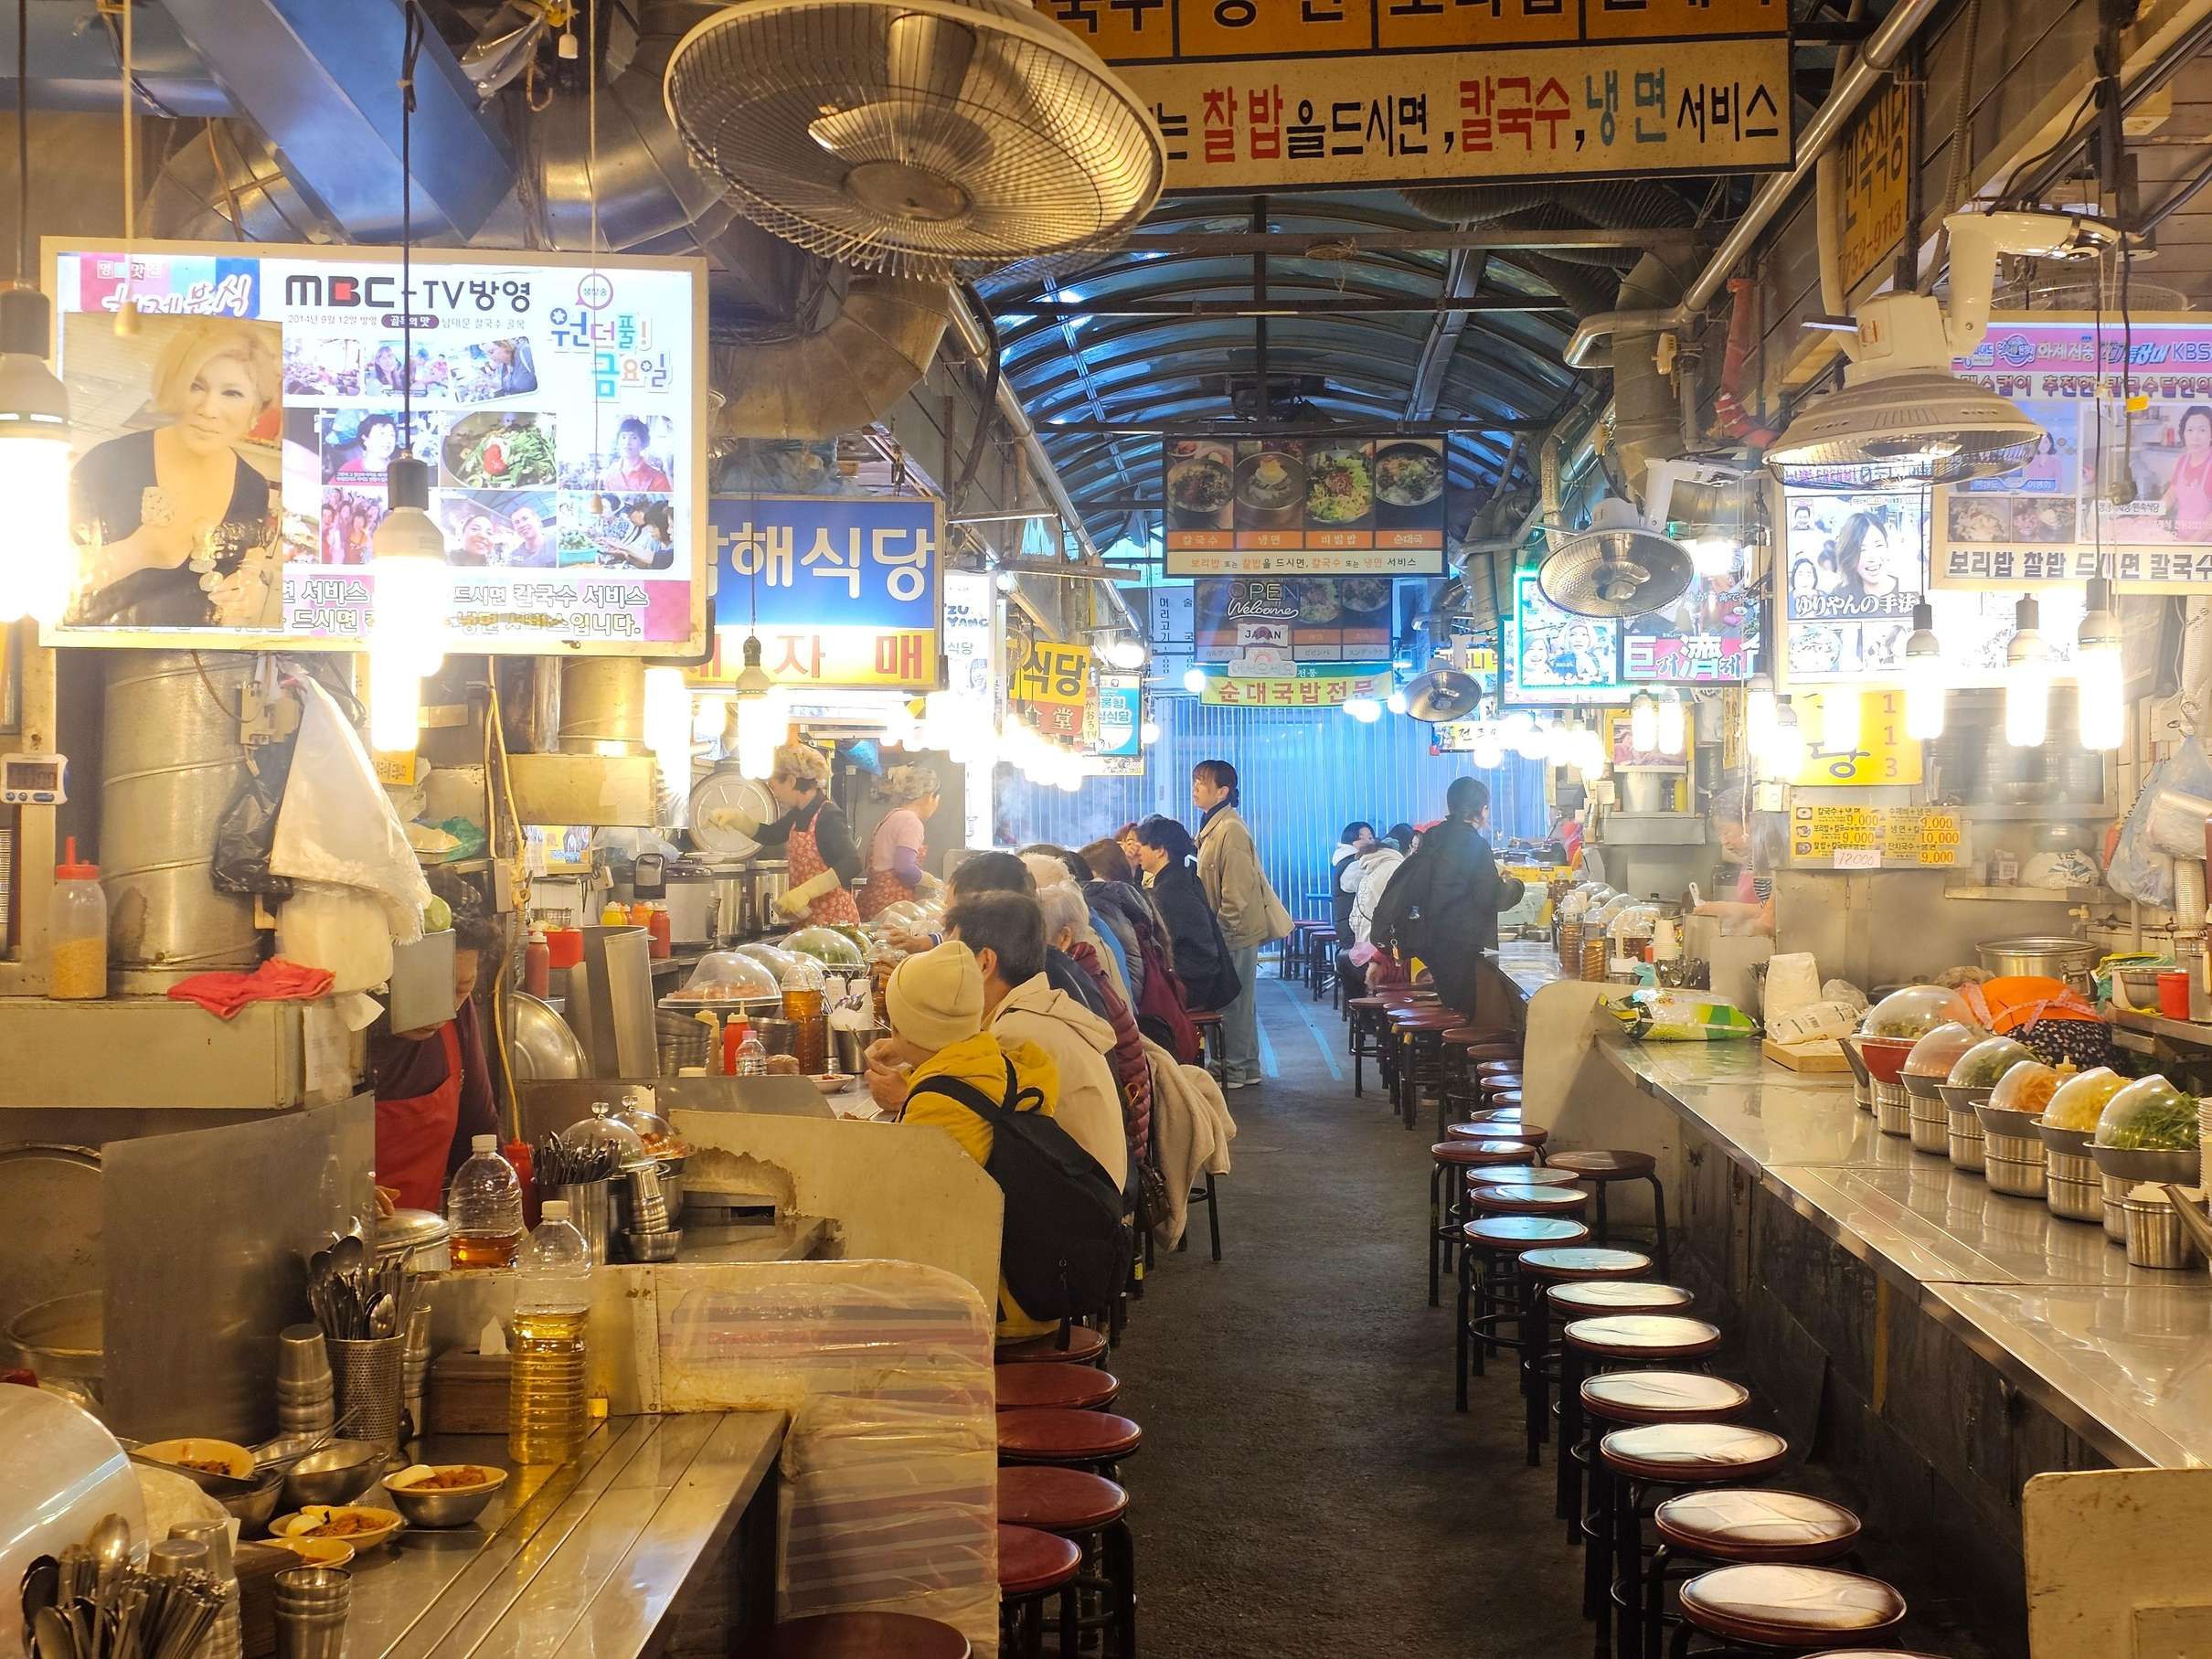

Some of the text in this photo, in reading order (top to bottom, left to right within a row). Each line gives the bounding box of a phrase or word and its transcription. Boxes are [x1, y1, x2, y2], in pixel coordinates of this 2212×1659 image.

[1148, 102, 1188, 161] 는
[1676, 81, 1779, 144] 서비스
[2174, 342, 2212, 361] KBS
[1183, 536, 1219, 547] 칼국수
[1257, 536, 1281, 547] 냉면
[1321, 535, 1357, 546] 비빔밥
[1393, 535, 1424, 546] 순대국
[1191, 558, 1220, 569] 보리밥
[1312, 558, 1342, 569] 칼국수
[1387, 557, 1417, 568] 서비스
[1949, 551, 2015, 578] 보리밥
[2023, 552, 2066, 579] 찰밥
[301, 580, 368, 605] 서비스
[453, 585, 505, 607] 드시면
[514, 583, 579, 608] 칼국수
[582, 586, 650, 608] 서비스
[1228, 581, 1302, 601] OPEN
[1227, 598, 1300, 621] Welcome
[292, 607, 358, 633] 드시면
[1015, 650, 1086, 697] 식당
